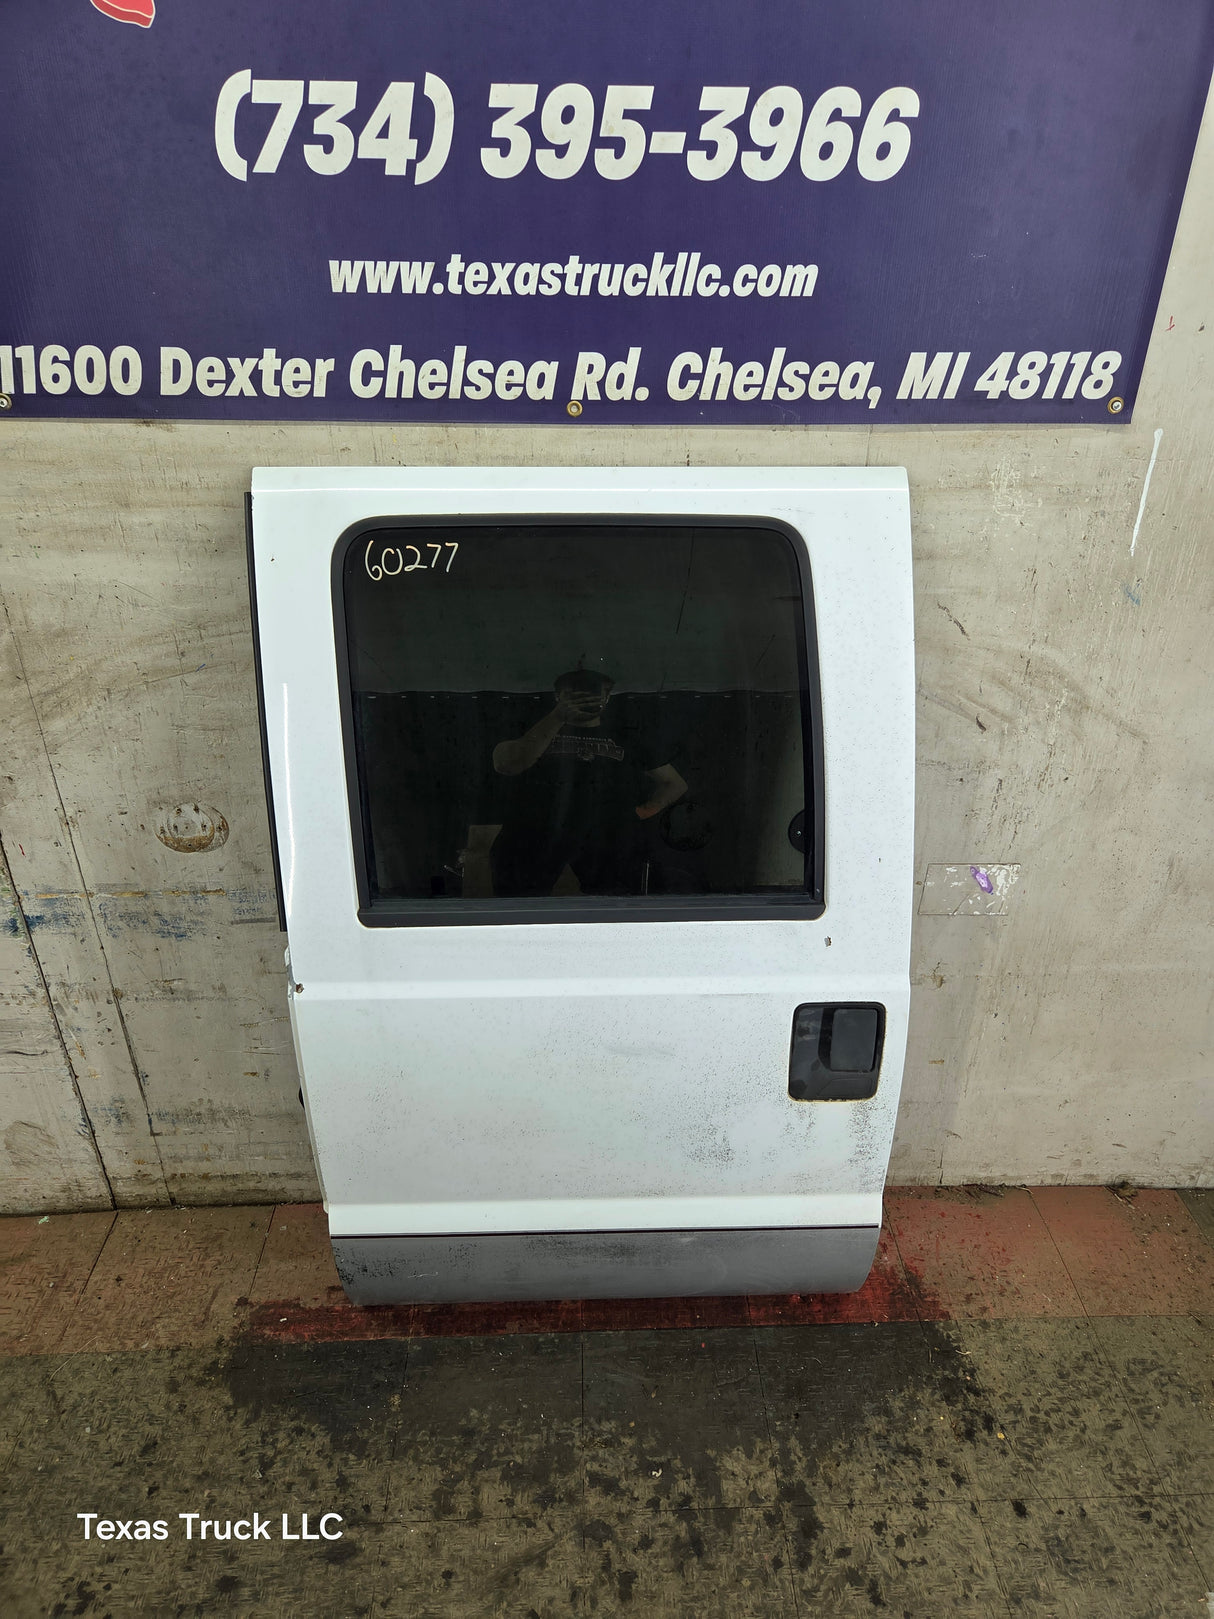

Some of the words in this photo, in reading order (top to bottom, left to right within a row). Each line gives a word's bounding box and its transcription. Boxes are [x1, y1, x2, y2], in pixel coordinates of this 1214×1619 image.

[214, 68, 455, 186] (734)
[480, 82, 921, 182] 395-3966
[328, 251, 819, 298] www.texastruckllc.com
[0, 344, 143, 396] 11600
[160, 346, 336, 398] Dexter
[349, 344, 560, 401] Chelsea
[570, 346, 650, 401] Rd.
[666, 347, 882, 409] Chelsea,
[895, 351, 972, 400] MI
[973, 350, 1123, 400] 48118
[364, 540, 459, 581] 60277
